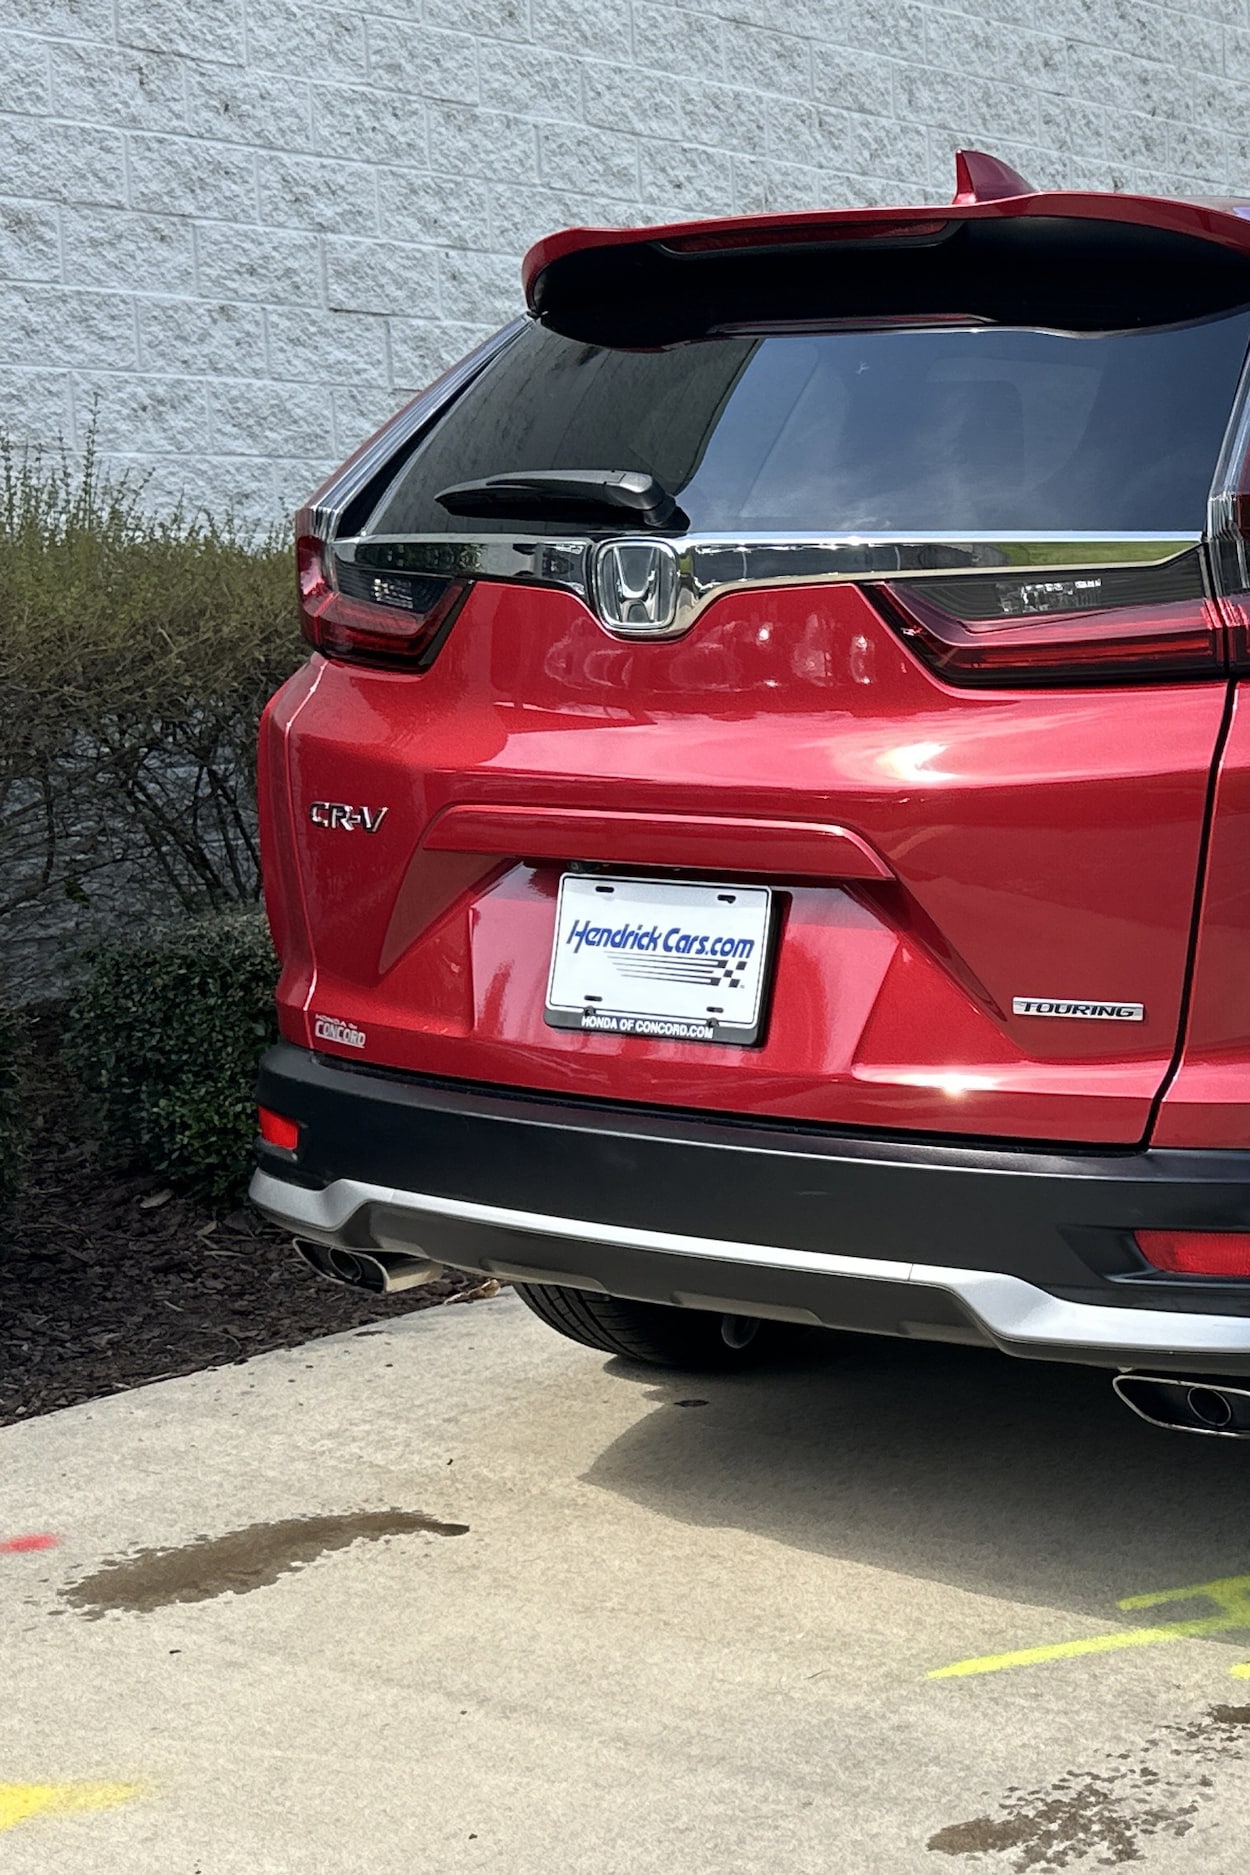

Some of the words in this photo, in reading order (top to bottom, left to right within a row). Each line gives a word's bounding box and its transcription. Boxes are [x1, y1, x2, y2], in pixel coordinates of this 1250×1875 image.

[309, 801, 389, 833] CR-V
[1021, 1001, 1135, 1018] TOURING
[315, 1020, 366, 1047] CONCORD
[581, 1016, 618, 1029] HONDA
[620, 1019, 634, 1030] OF
[635, 1021, 714, 1039] CONCORD.COM
